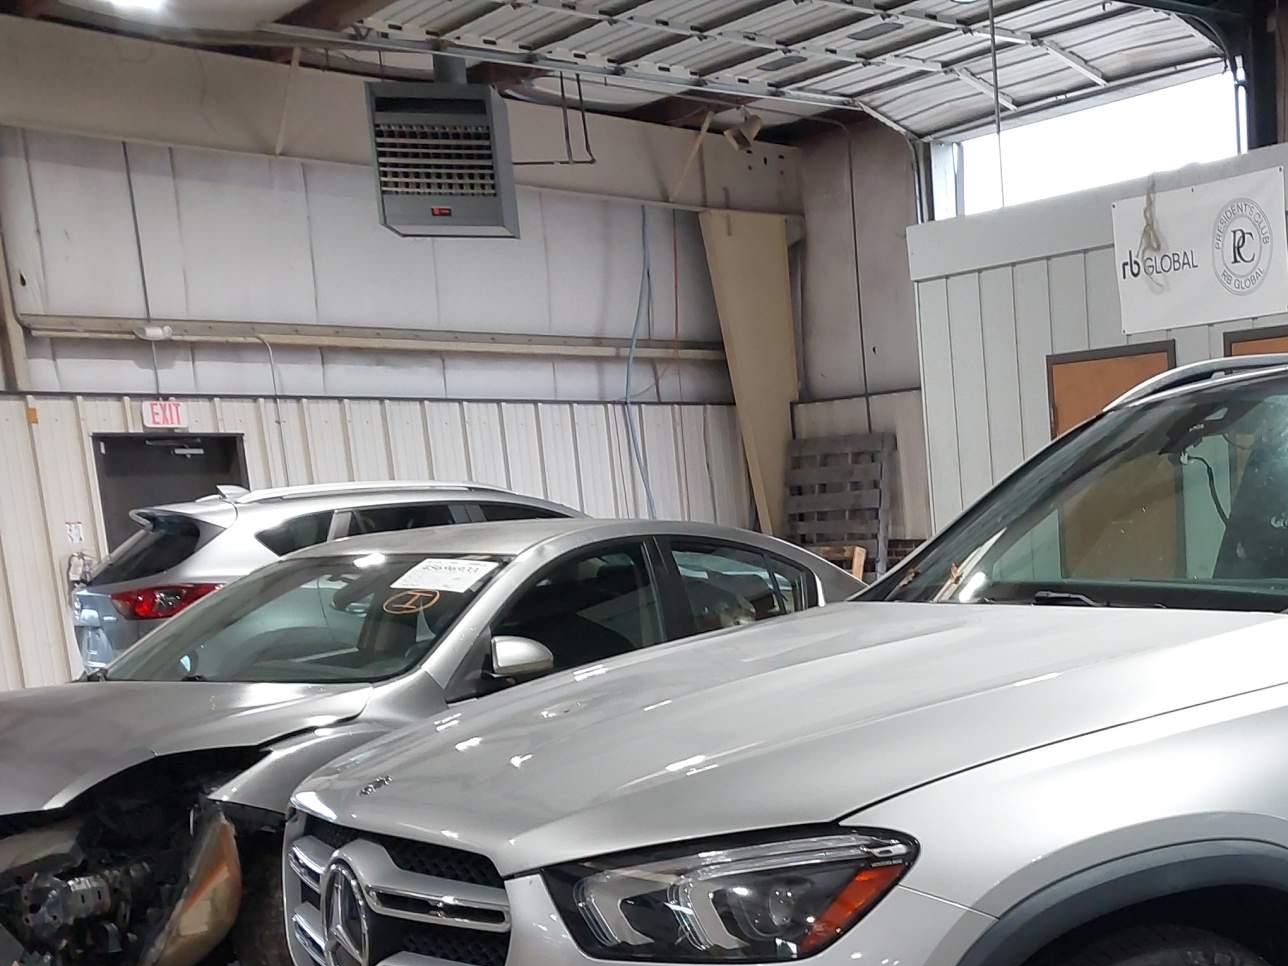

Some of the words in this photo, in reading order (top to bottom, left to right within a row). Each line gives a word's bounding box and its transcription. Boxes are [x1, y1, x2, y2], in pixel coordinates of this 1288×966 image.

[1253, 212, 1270, 245] CLUB
[1121, 250, 1141, 280] rb
[1143, 250, 1199, 276] GLOBAL
[1222, 269, 1233, 286] RB
[1234, 267, 1264, 290] GLOBAL
[150, 402, 181, 425] EXIT
